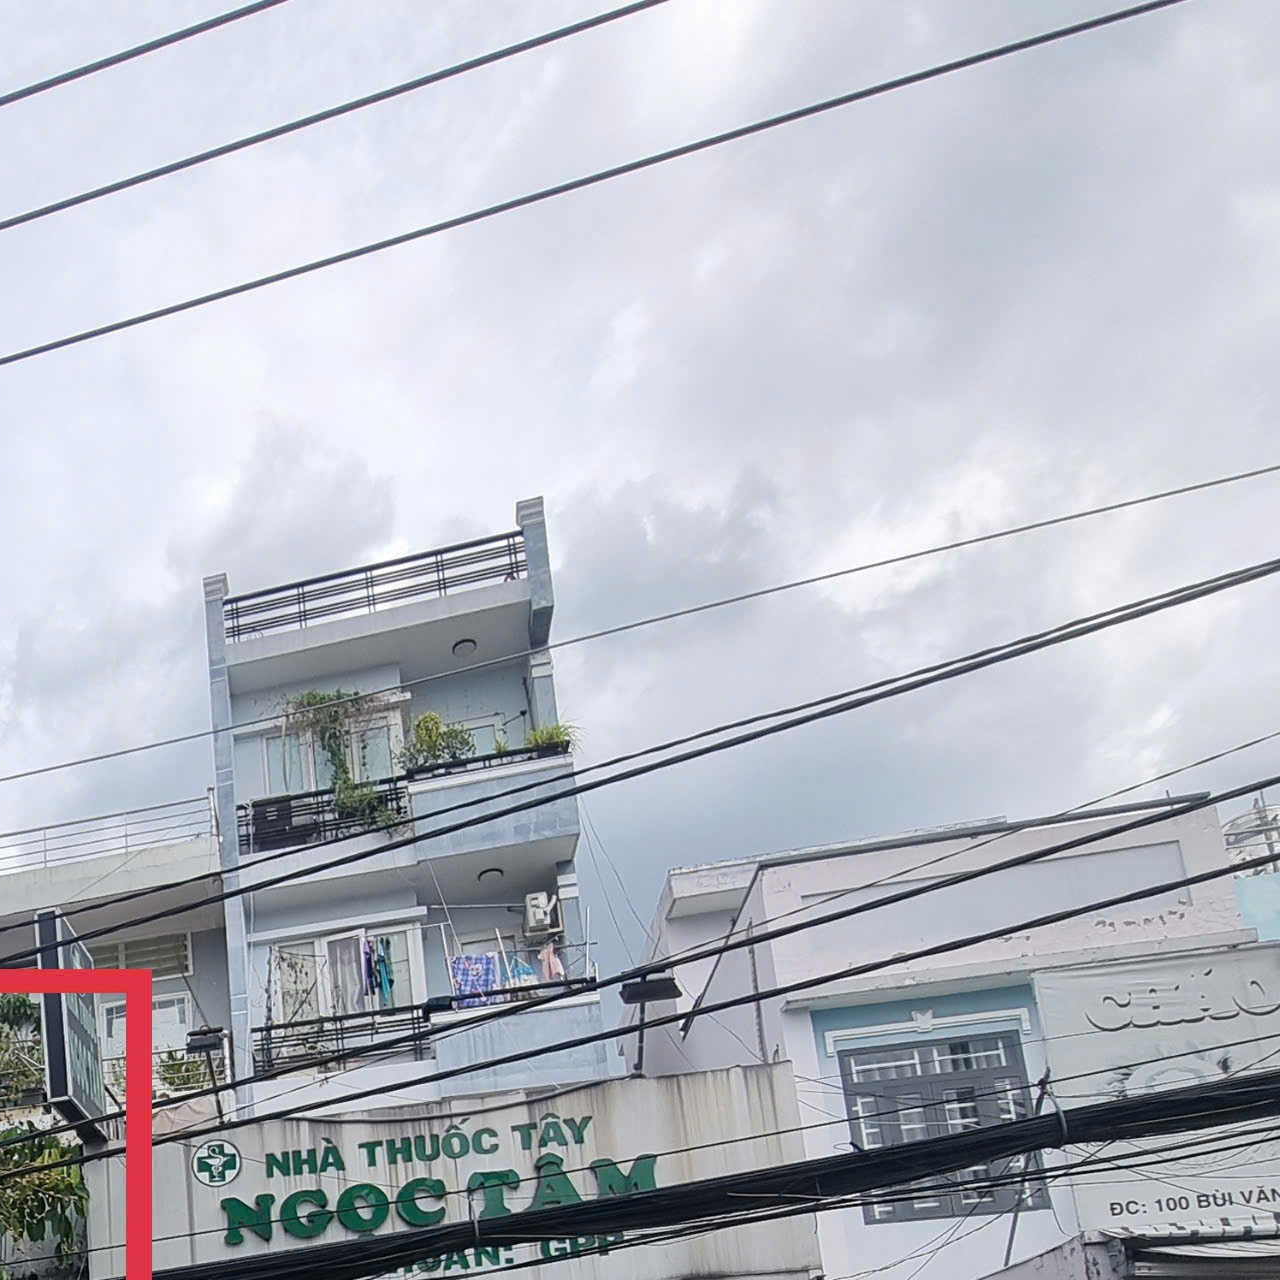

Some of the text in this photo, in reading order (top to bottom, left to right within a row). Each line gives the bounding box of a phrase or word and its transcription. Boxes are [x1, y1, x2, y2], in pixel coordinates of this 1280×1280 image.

[265, 1113, 592, 1178] NHÀ THUỐC TÂY
[221, 1152, 658, 1245] NGỌC TÂM
[1110, 1200, 1147, 1216] ĐC:
[1154, 1197, 1189, 1212] 100
[1196, 1189, 1233, 1209] BÙI
